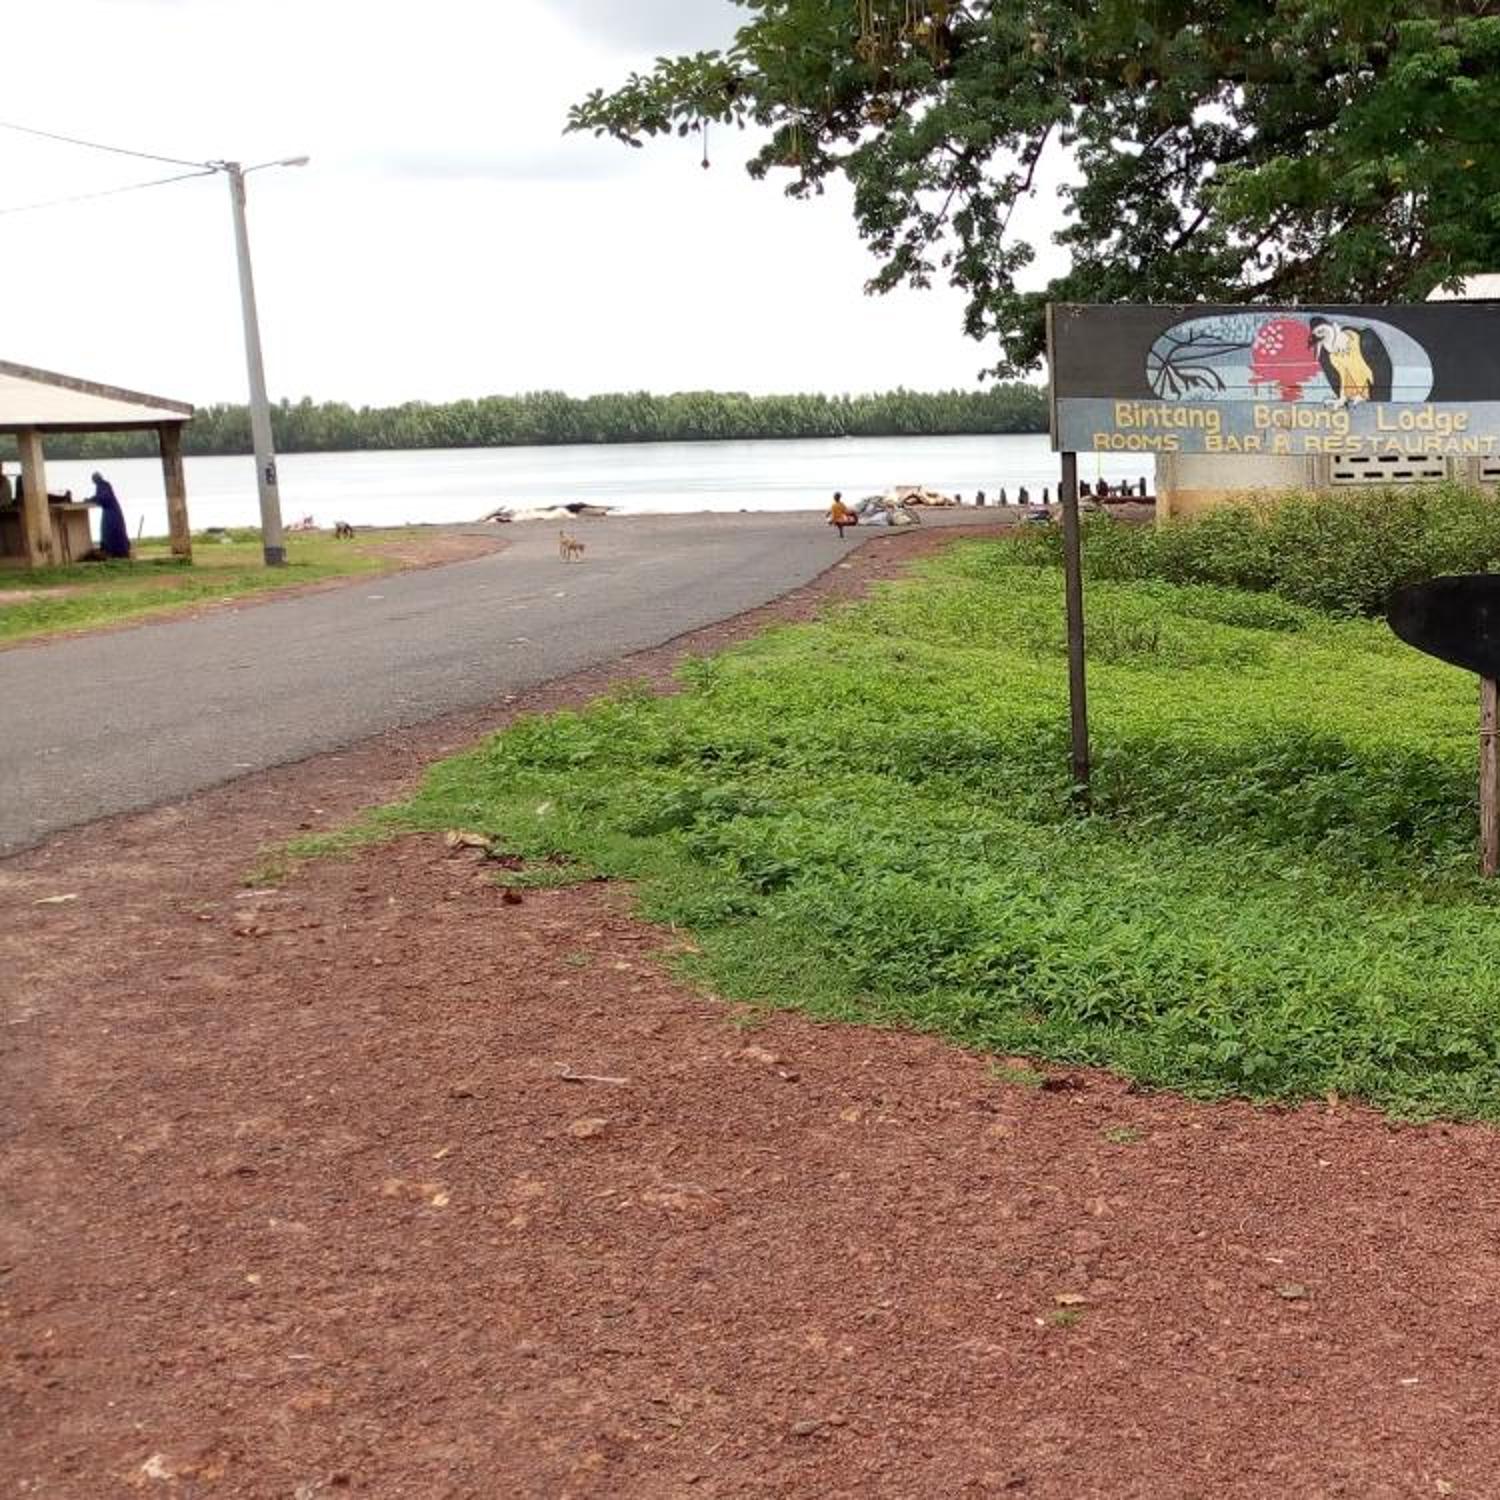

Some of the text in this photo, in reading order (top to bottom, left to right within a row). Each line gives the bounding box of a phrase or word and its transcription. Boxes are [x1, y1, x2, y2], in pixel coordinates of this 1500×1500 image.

[1114, 401, 1221, 434] Bintang
[1376, 403, 1470, 436] Lodge
[1093, 432, 1181, 450] ROOMS
[1203, 434, 1261, 452] BAR
[1304, 434, 1499, 453] RESTAURANT
